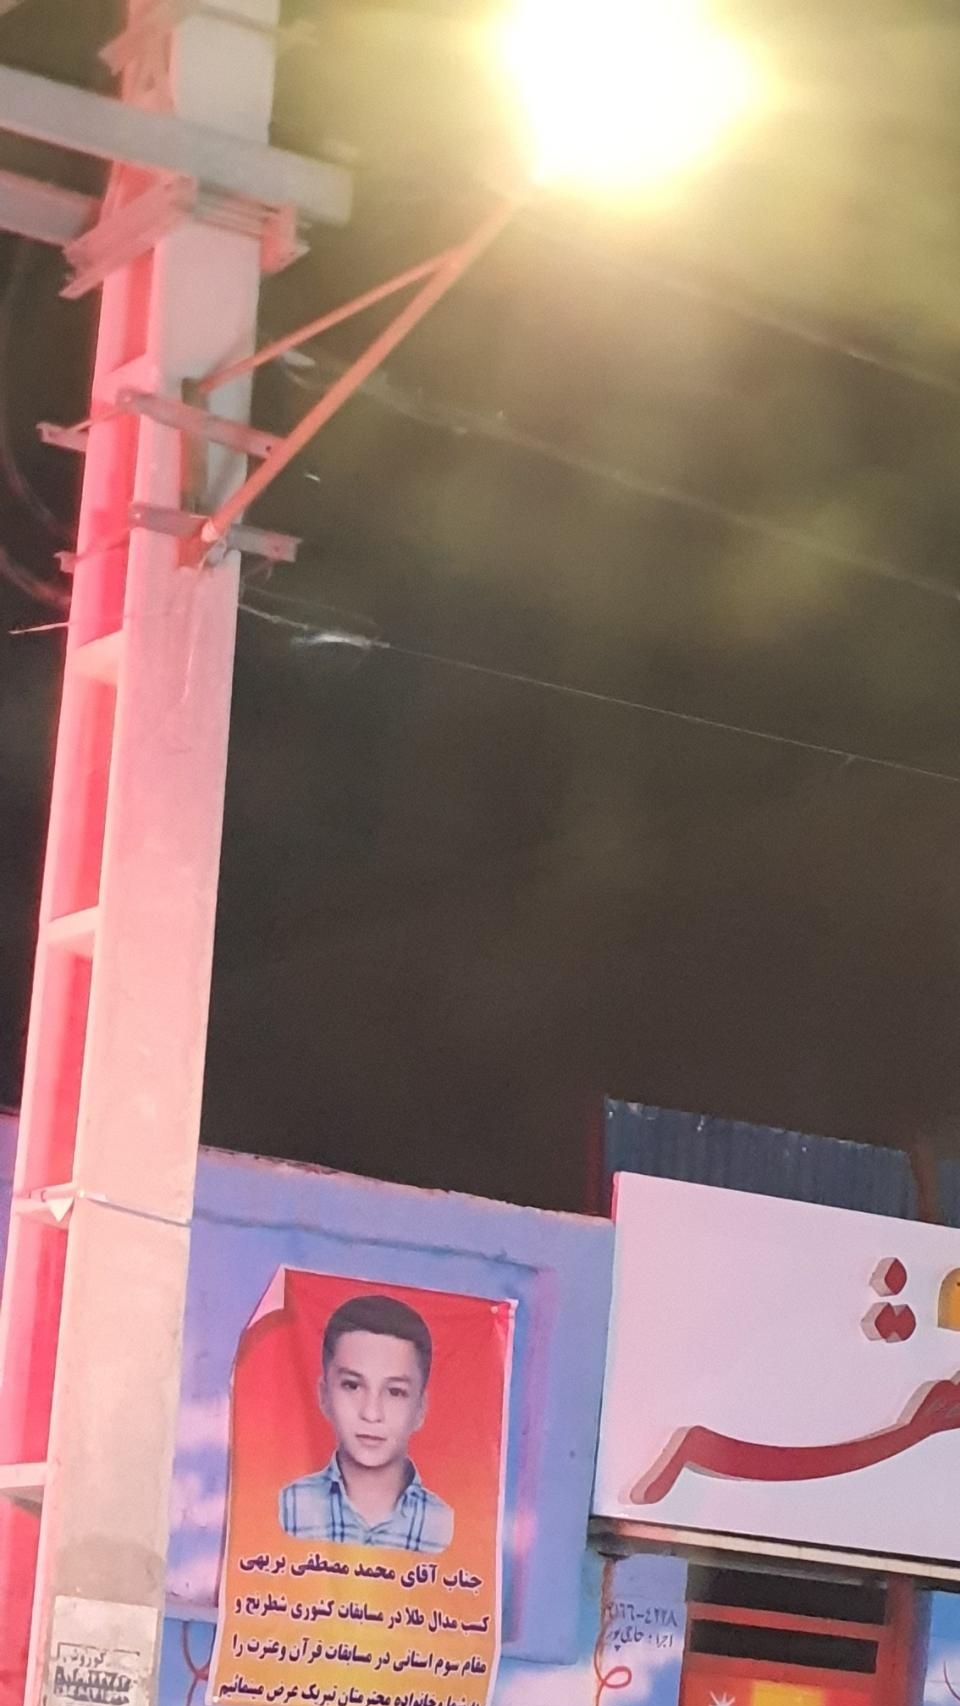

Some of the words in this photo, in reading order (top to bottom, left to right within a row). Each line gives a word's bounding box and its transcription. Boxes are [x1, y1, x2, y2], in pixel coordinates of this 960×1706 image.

[291, 1553, 350, 1577] مصطفی
[354, 1562, 396, 1580] محمد
[400, 1563, 438, 1588] آقای
[442, 1568, 482, 1593] جناب
[234, 1597, 243, 1614] و
[246, 1593, 288, 1617] شطرنج
[291, 1599, 335, 1621] کشوری
[338, 1602, 385, 1625] مسابقات
[405, 1606, 425, 1626] طلا
[387, 1610, 403, 1630] در
[428, 1610, 458, 1633] مدال
[462, 1615, 490, 1634] کسب
[232, 1634, 243, 1658] را
[288, 1637, 322, 1665] قرآن
[324, 1643, 373, 1666] مسابقات
[374, 1652, 391, 1671] در
[393, 1650, 433, 1672] استانی
[434, 1657, 460, 1676] سوم
[461, 1654, 487, 1677] مقام
[266, 1685, 299, 1704] عرض
[300, 1682, 338, 1705] تبریک
